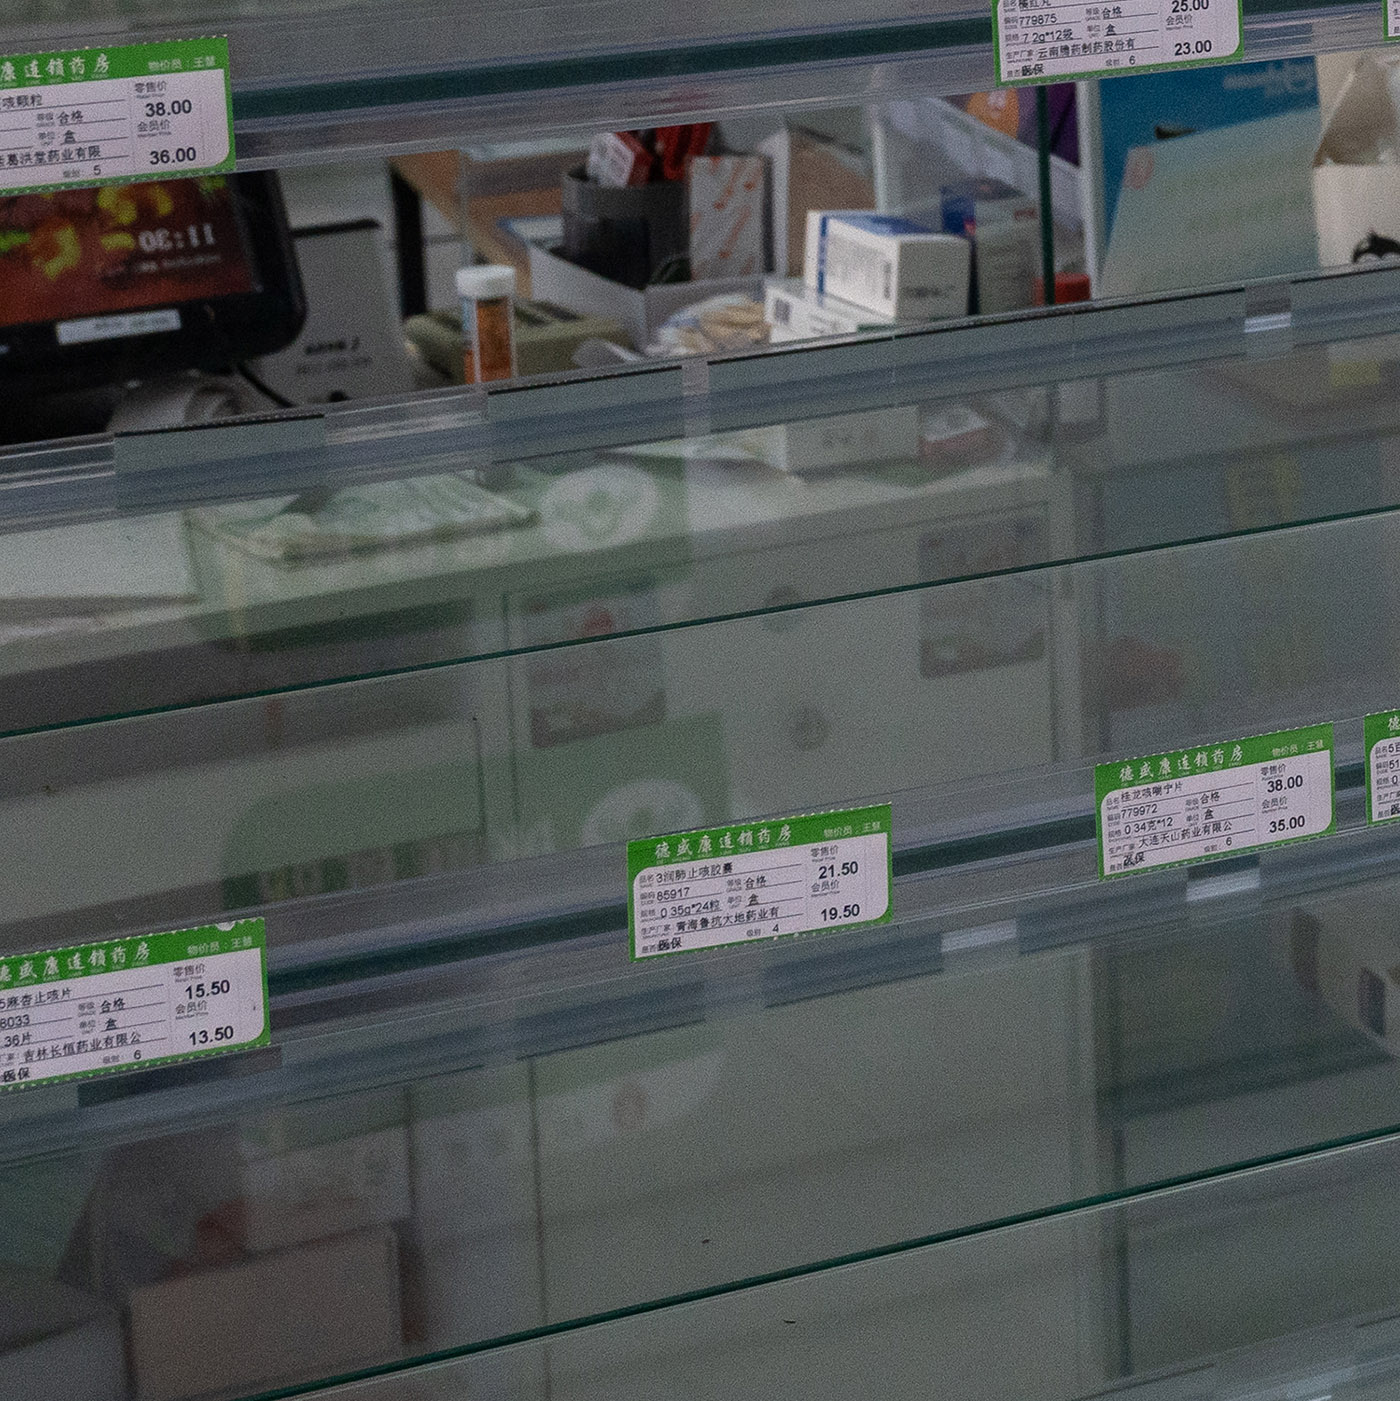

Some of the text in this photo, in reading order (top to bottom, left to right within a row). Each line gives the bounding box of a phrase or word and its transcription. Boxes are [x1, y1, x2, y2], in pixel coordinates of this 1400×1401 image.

[1019, 14, 1057, 25] 779875
[1174, 40, 1212, 56] 23.00
[145, 99, 192, 117] 38.00
[150, 147, 196, 165] 36.00
[1267, 775, 1303, 793] 38.00
[1121, 804, 1158, 818] 779972
[1269, 815, 1305, 833] 35.00
[818, 861, 859, 880] 21.50
[657, 887, 690, 901] 85917
[821, 904, 861, 922] 19.50
[185, 979, 231, 1000] 15.50
[188, 1026, 234, 1046] 13.50
